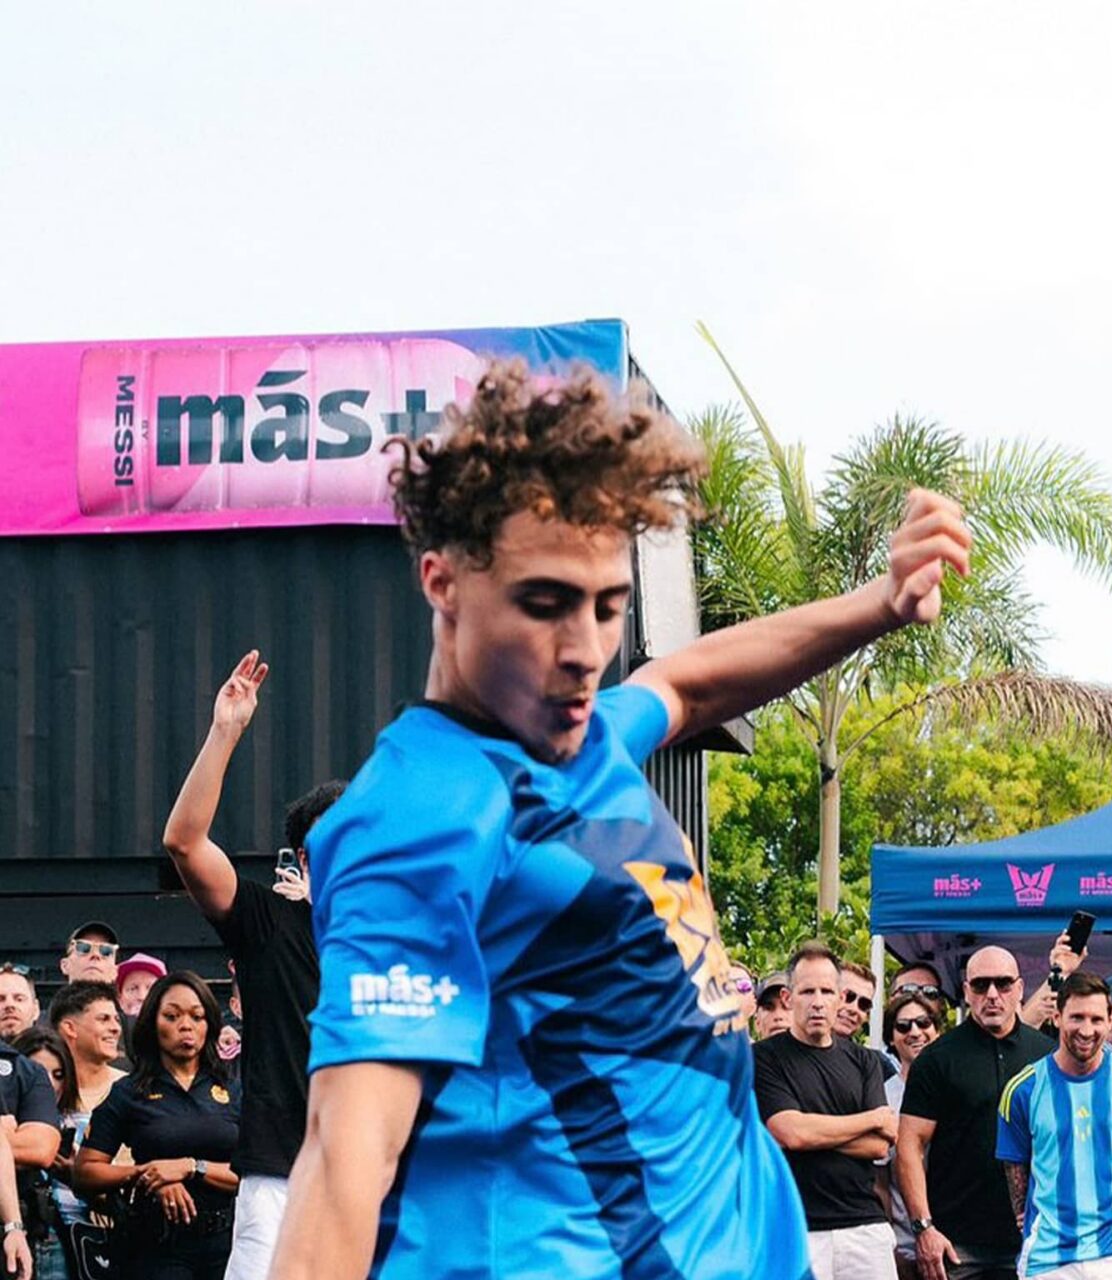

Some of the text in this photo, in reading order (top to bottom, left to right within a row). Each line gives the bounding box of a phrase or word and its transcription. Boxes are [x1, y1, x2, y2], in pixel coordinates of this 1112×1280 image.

[114, 375, 135, 486] MESSI
[934, 873, 982, 891] más+
[350, 963, 460, 1006] más+
